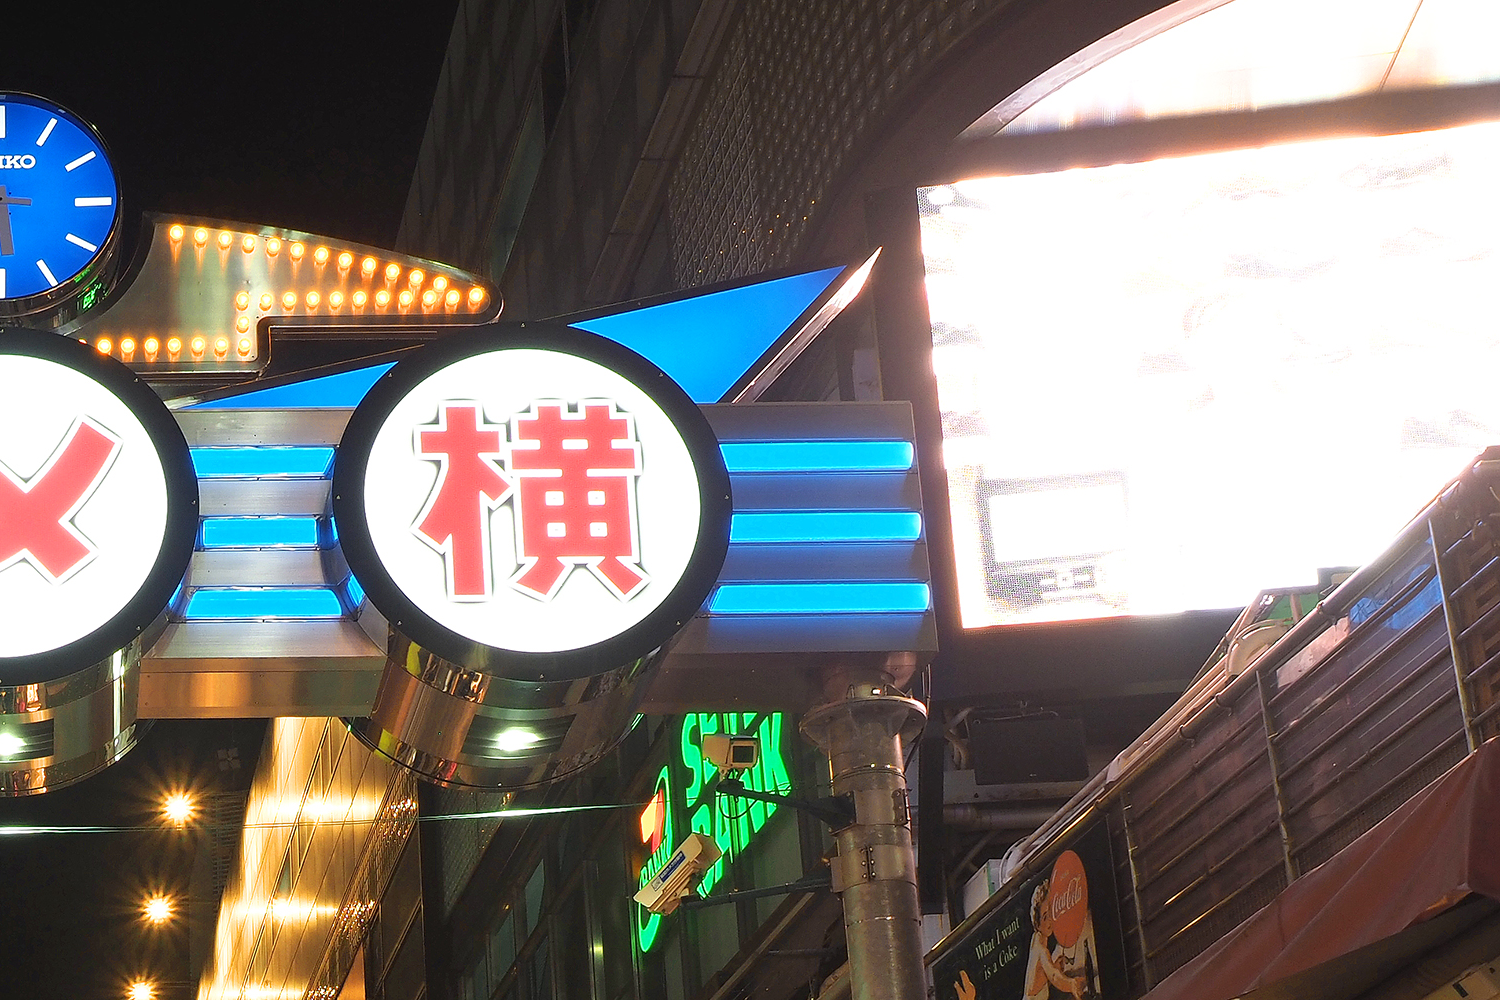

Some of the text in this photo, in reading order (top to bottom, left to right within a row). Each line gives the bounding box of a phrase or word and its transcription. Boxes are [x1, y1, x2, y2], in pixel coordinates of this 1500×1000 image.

[975, 916, 1020, 960] What I want
[983, 945, 1018, 981] is a Coke
